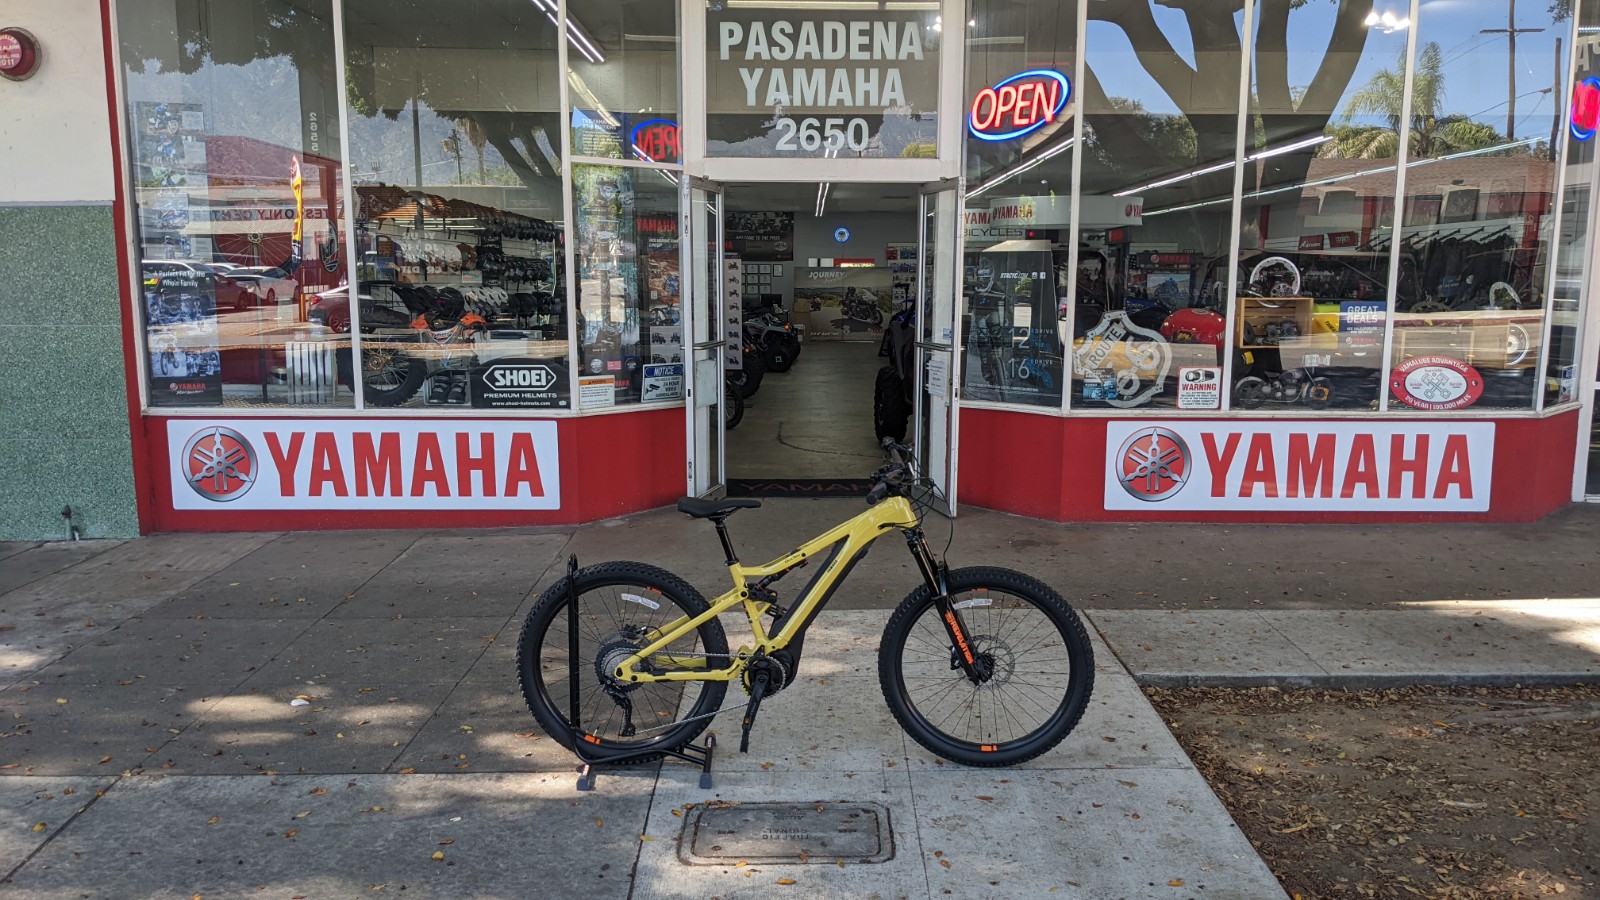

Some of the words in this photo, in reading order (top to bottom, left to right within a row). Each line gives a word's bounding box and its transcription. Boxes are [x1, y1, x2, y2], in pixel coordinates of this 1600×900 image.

[719, 20, 924, 61] PASADENA
[2, 58, 14, 66] 911
[738, 67, 906, 107] YAMAHA
[971, 79, 1059, 130] OPEN
[775, 117, 870, 152] 2650
[997, 204, 1033, 219] YAMAHA
[636, 218, 676, 232] YAMAHA
[964, 228, 1023, 237] BICYCLES
[1347, 305, 1379, 314] GREAT
[1346, 314, 1378, 324] DEALS
[1008, 327, 1030, 349] 12
[1088, 327, 1122, 366] ROUTE
[653, 366, 674, 376] NOTICE
[1008, 357, 1030, 379] 16
[1399, 357, 1431, 373] YAMALUBE
[1431, 357, 1469, 373] ADVANTAGE
[493, 369, 547, 386] SHOEI
[1182, 383, 1217, 391] WARNING
[1413, 400, 1429, 409] YEAR
[1456, 393, 1472, 406] MILES
[263, 431, 545, 497] YAMAHA
[1200, 432, 1474, 499] YAMAHA
[740, 483, 874, 492] YAMAH
